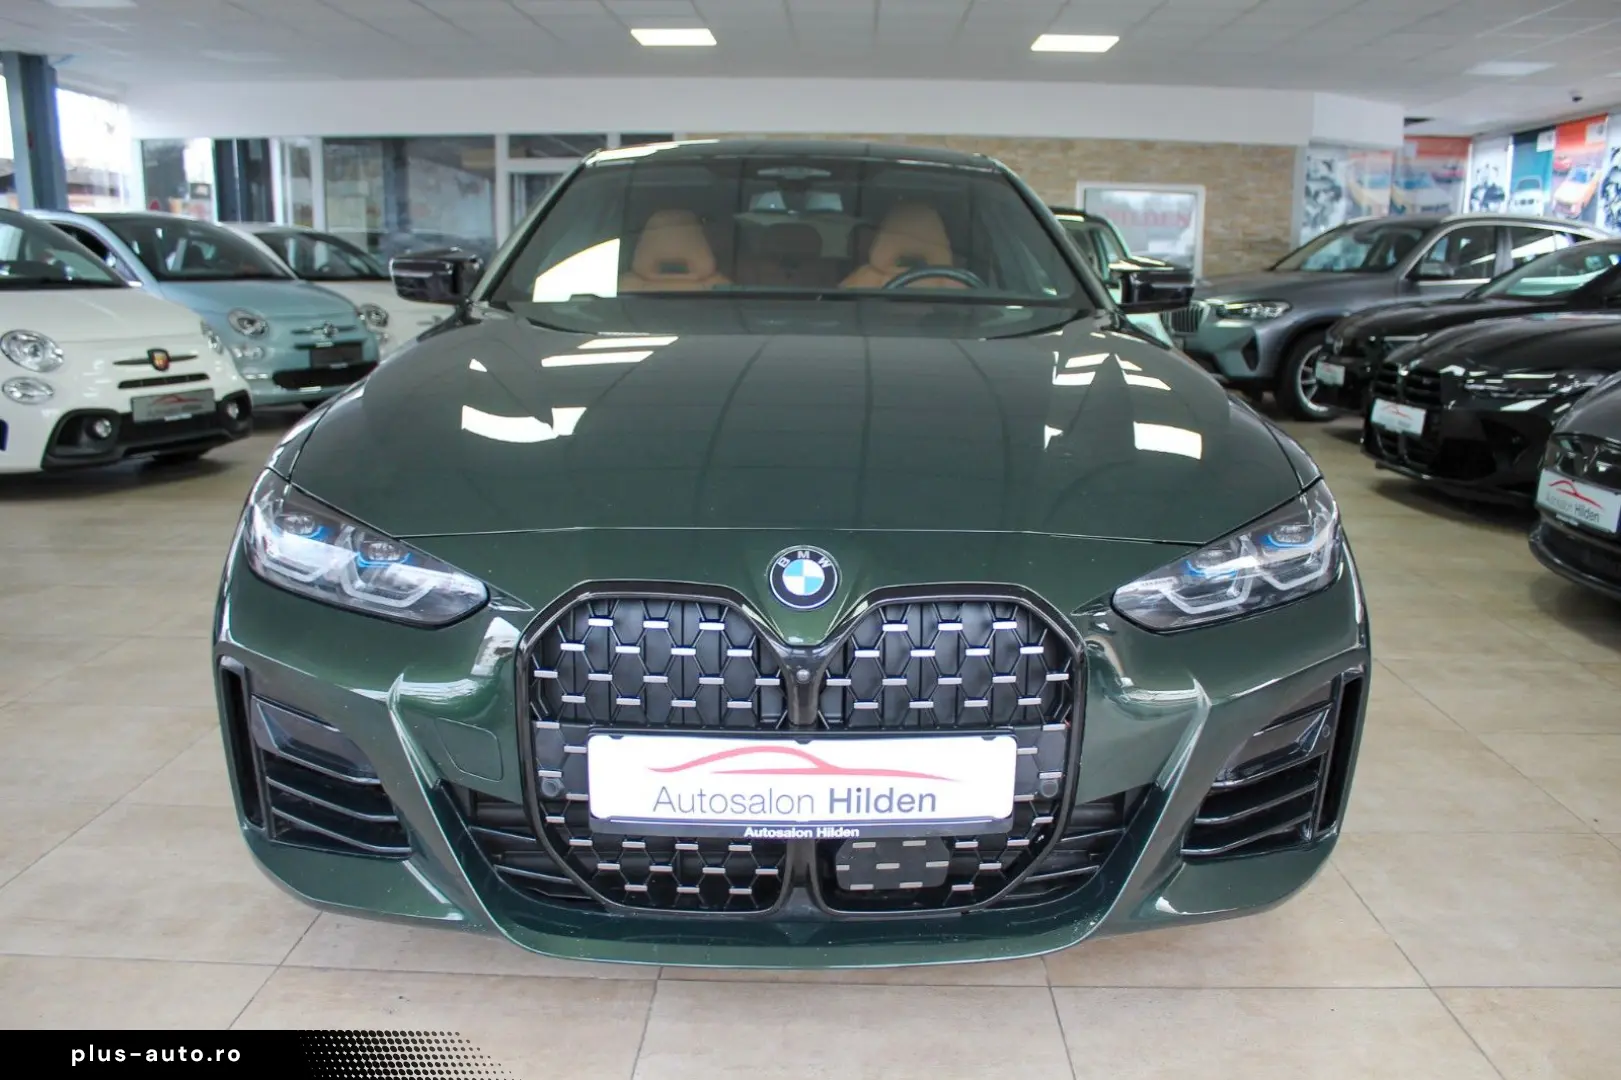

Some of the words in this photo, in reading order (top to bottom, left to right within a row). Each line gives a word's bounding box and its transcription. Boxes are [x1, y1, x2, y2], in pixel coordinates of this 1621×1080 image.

[1574, 502, 1600, 523] Hilden
[777, 550, 831, 568] BMW
[652, 785, 815, 815] Autosalon
[829, 786, 936, 814] Hilden
[743, 826, 813, 838] Autosalon
[816, 826, 860, 838] Hilden
